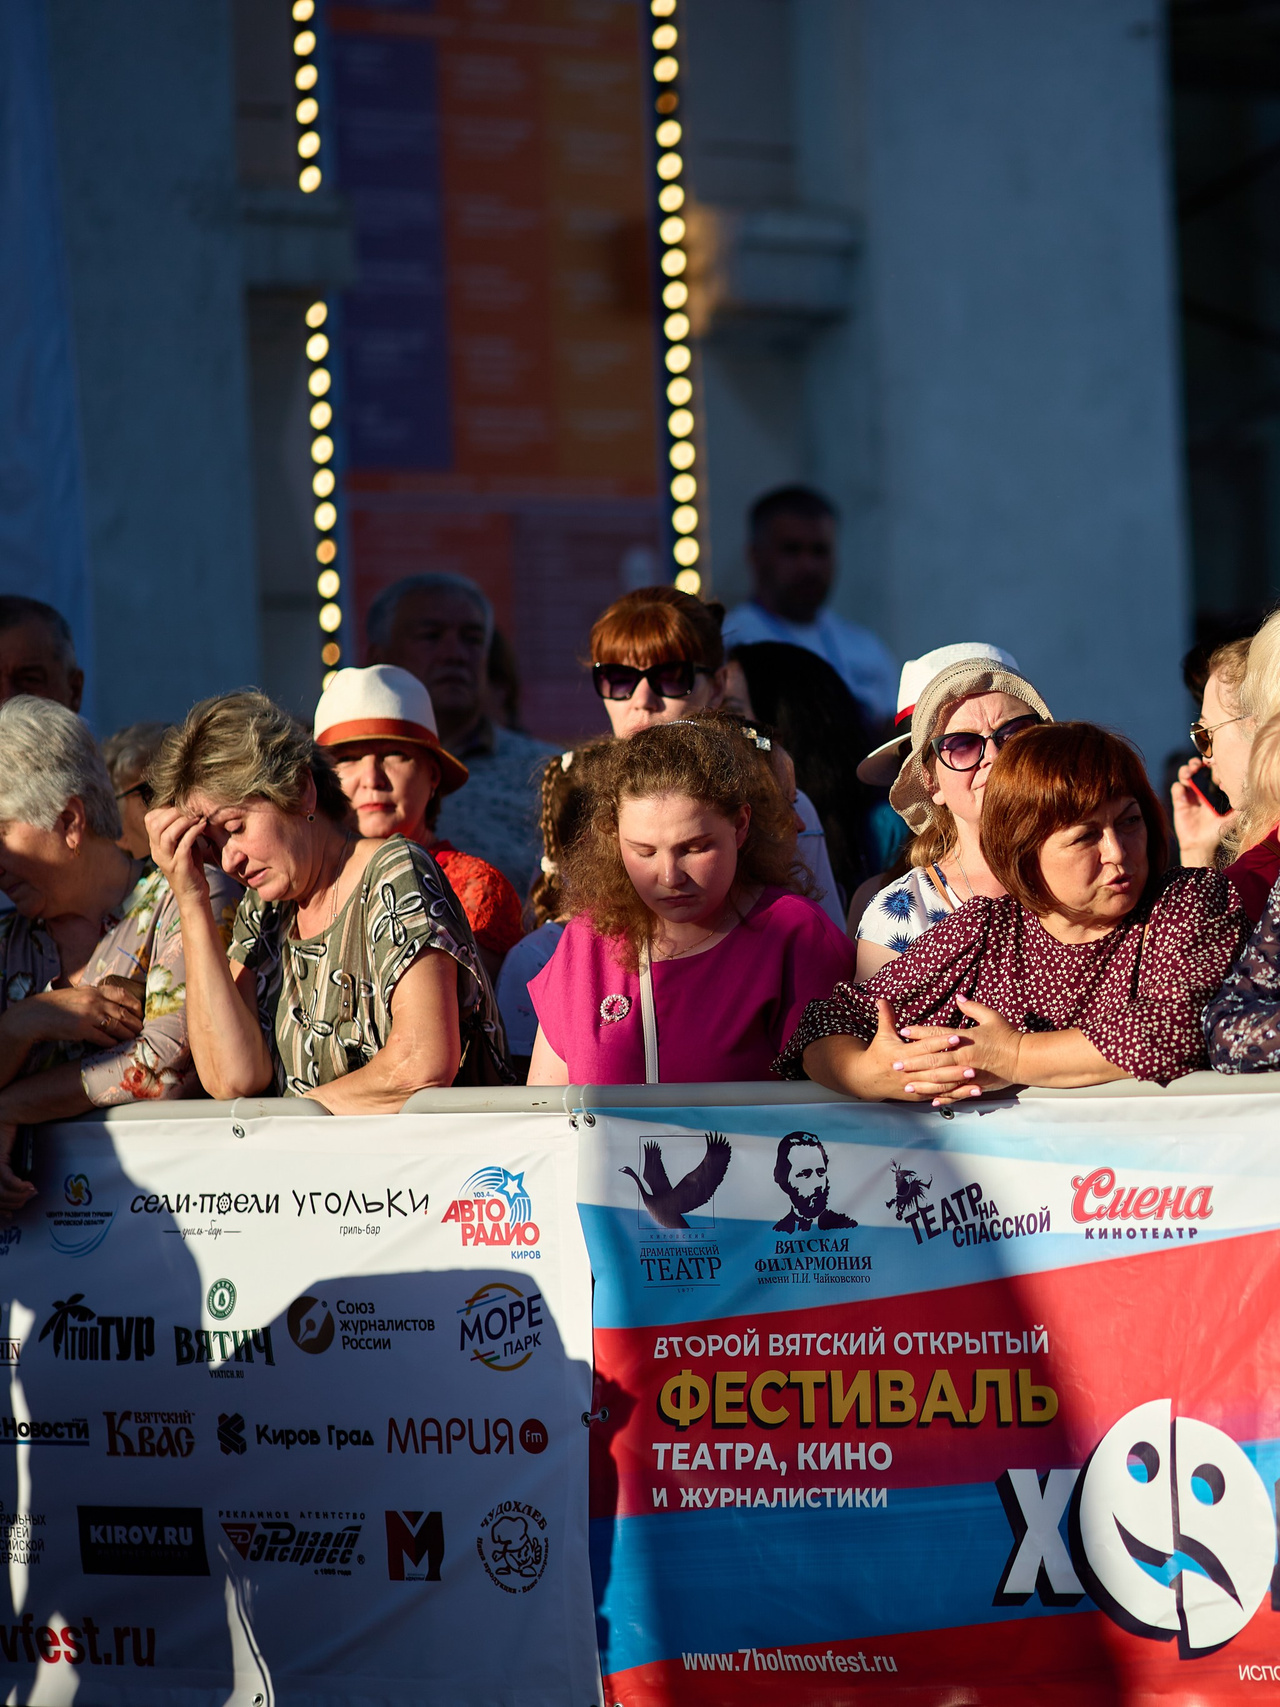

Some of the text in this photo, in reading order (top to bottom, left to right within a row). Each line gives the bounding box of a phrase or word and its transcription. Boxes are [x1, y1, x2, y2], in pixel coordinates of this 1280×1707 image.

[292, 1188, 429, 1217] УГОЛЬКИ
[1071, 1166, 1214, 1224] Смена
[441, 1199, 506, 1223] АВТО
[904, 1182, 983, 1245] ТЕАТР
[979, 1200, 1000, 1221] НА
[340, 1224, 381, 1236] гриль-бар
[461, 1222, 540, 1246] РАДИО
[952, 1206, 1051, 1248] СПАССКОЙ
[1085, 1227, 1199, 1240] КИНОТЕАТР
[511, 1250, 541, 1260] КИРОВ
[640, 1244, 720, 1258] ДРАМАТИЧЕСКИЙ
[775, 1238, 849, 1255] ВЯТСКАЯ
[640, 1257, 721, 1281] ТЕАТР
[754, 1256, 872, 1273] ФИЛАРМОНИЯ
[757, 1273, 871, 1284] имени П.И. Чайковского
[336, 1300, 375, 1314] Союз
[339, 1319, 435, 1334] журналистов
[460, 1293, 543, 1351] МОРЕ
[174, 1326, 275, 1366] ВЯТИЧ
[342, 1335, 391, 1350] России
[504, 1332, 542, 1357] ПАРК
[653, 1325, 1049, 1359] ВТОРОЙ ВЯТСКИЙ ОТКРЫТЫЙ
[209, 1370, 244, 1379] VYATICH.RU
[657, 1369, 1059, 1431] ФЕСТИВАЛЬ
[134, 1410, 192, 1424] ВЯТСКИЙ
[256, 1424, 374, 1450] Киров Град
[387, 1417, 514, 1454] МАРИЯ
[652, 1442, 893, 1476] ТЕАТРА, КИНО
[652, 1487, 888, 1508] И ЖУРНАЛИСТИКИ
[300, 1511, 365, 1520] АГЕНТСТВО
[481, 1501, 547, 1530] ЧУДОХЛЕБ
[89, 1524, 194, 1546] KIROV.RU
[682, 1648, 898, 1674] www.7holmovfest.ru
